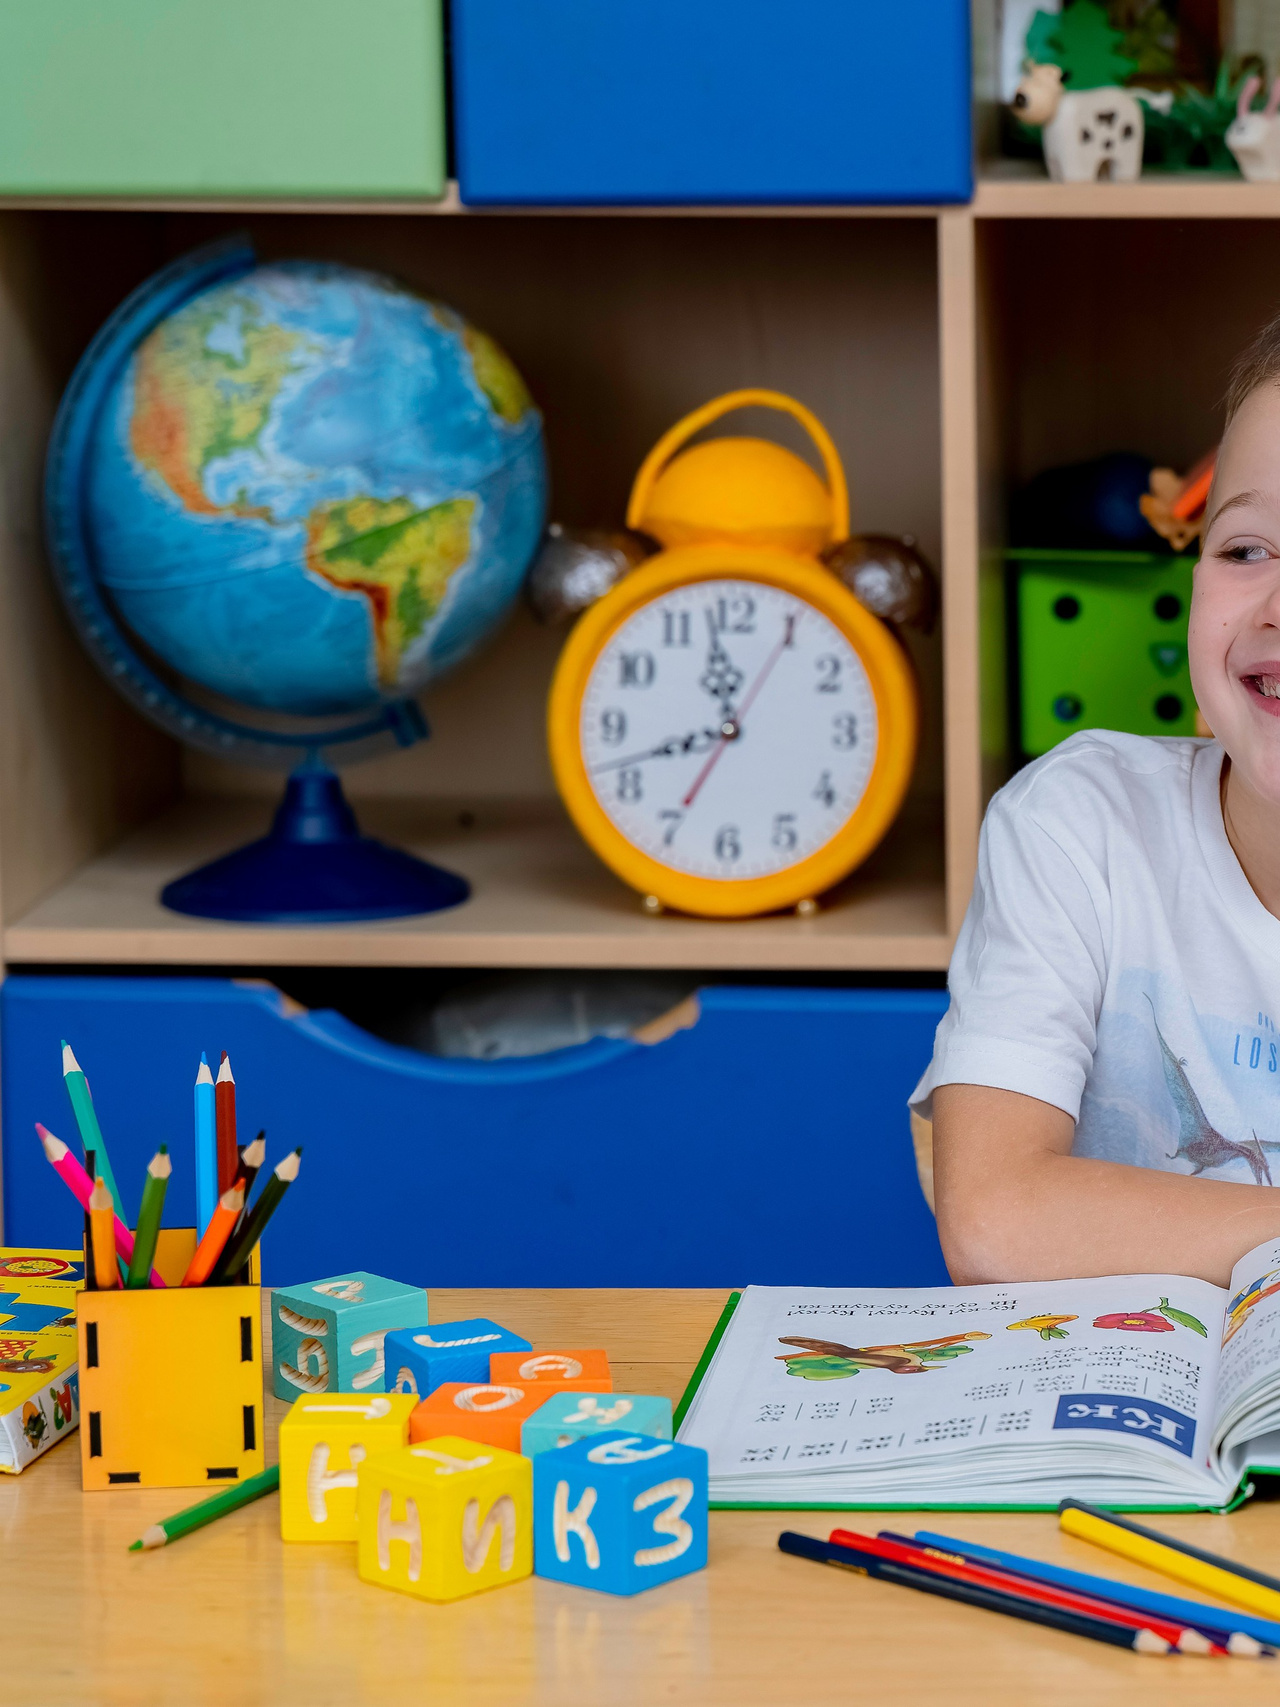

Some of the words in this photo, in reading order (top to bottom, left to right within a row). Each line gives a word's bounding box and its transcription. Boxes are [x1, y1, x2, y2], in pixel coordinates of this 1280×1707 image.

[662, 608, 690, 647] 11
[717, 597, 756, 634] 12
[783, 613, 797, 648] 1
[617, 650, 656, 689] 10
[815, 653, 842, 695] 2
[600, 707, 627, 747] 9
[831, 711, 859, 751] 3
[616, 765, 644, 804] 8
[812, 769, 838, 810] 4
[658, 807, 685, 848] 7
[713, 823, 742, 864] 6
[771, 811, 799, 852] 5
[377, 1489, 423, 1582] Н
[461, 1494, 516, 1574] И
[553, 1479, 600, 1570] К
